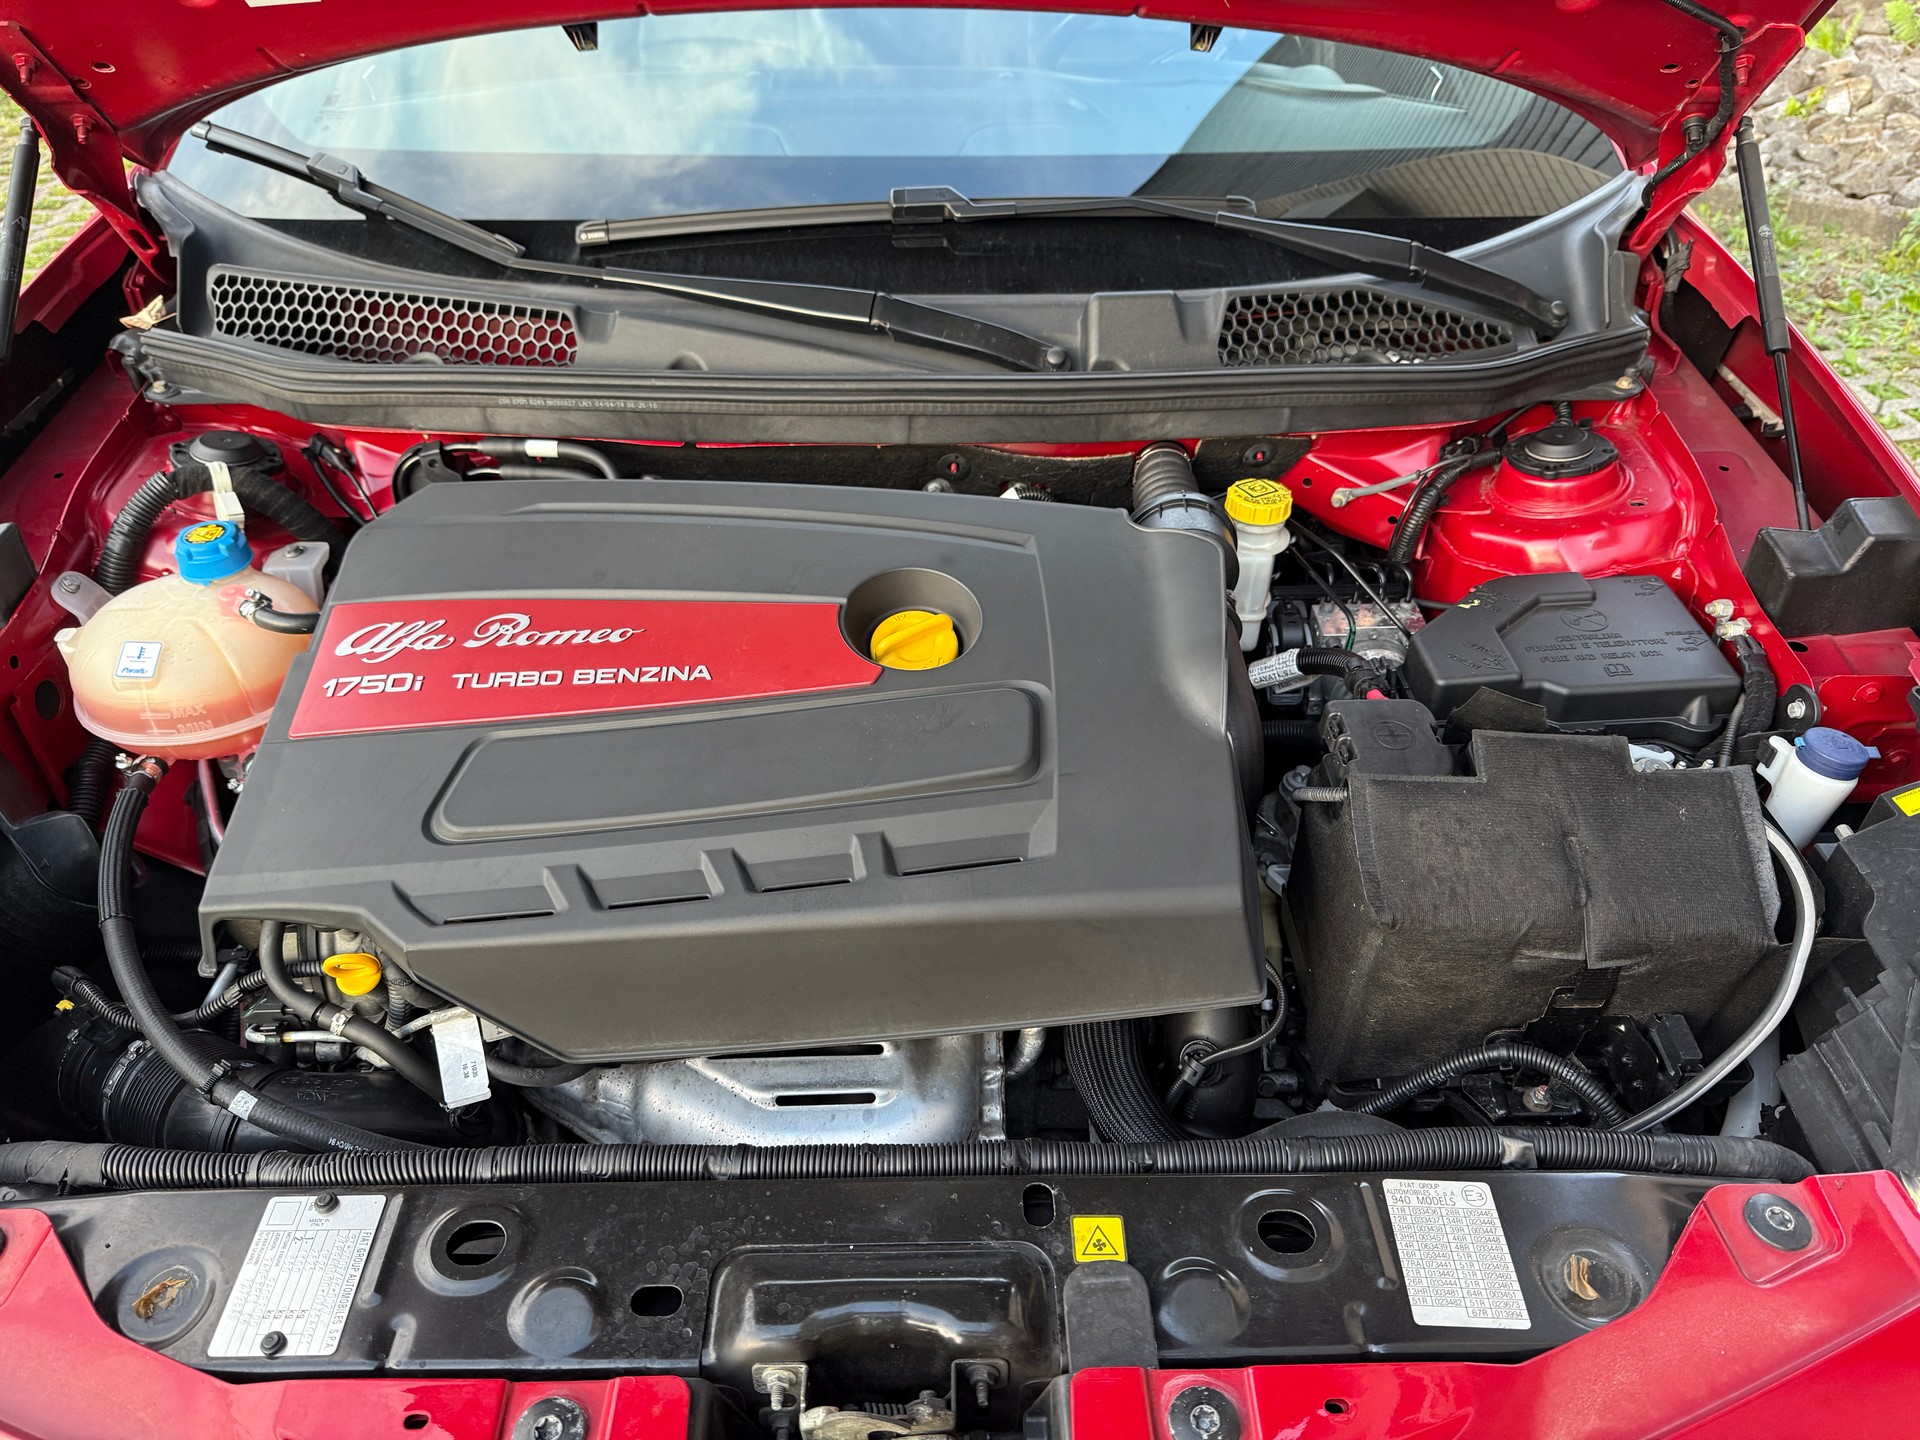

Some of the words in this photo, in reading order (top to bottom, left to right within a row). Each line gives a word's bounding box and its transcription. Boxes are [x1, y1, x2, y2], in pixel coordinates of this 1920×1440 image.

[334, 619, 455, 664] Alfa
[462, 613, 645, 648] Romeo
[322, 672, 425, 698] 1750i
[452, 671, 564, 690] TURBO
[573, 665, 712, 686] BENZINA
[171, 703, 208, 720] MAX
[176, 719, 215, 734] MIN
[1391, 1195, 1411, 1205] 940
[1416, 1196, 1456, 1206] MODELS
[359, 1231, 371, 1246] FIAT
[352, 1248, 366, 1272] GROUP
[332, 1273, 357, 1324] AUTOMOBILES
[262, 1309, 275, 1319] kg
[274, 1309, 286, 1318] kg
[285, 1309, 297, 1318] kg
[297, 1309, 308, 1318] kg
